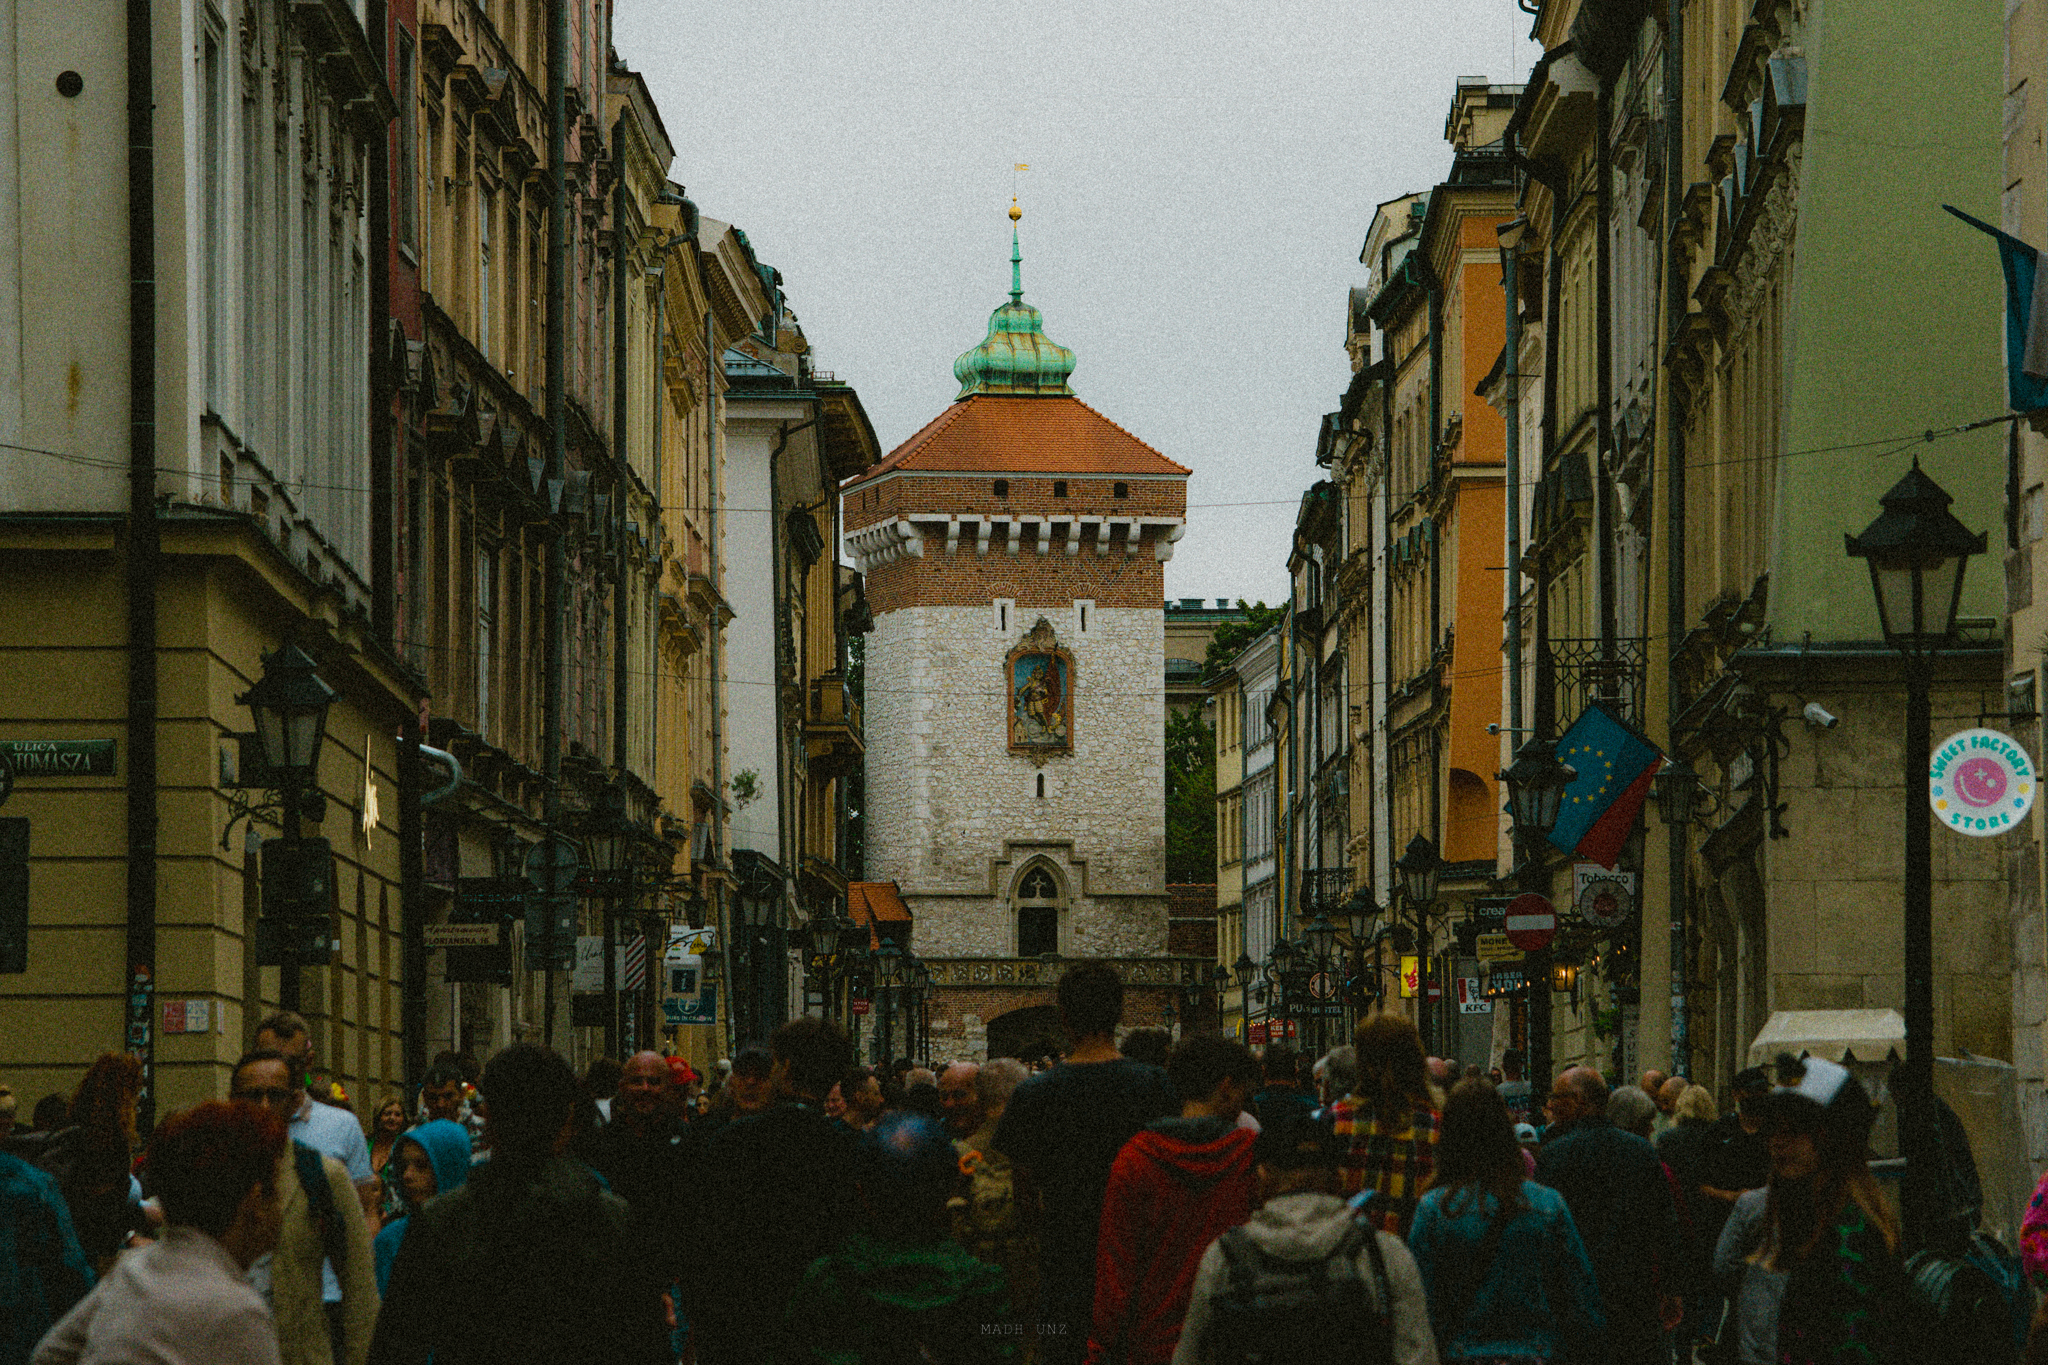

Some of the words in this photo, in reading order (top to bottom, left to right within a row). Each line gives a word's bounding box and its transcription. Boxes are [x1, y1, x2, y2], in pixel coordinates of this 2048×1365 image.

[13, 742, 58, 752] ULICA
[13, 752, 92, 772] TOMASZA
[1930, 739, 1966, 779] SWEET
[1970, 736, 2030, 776] FACTORY
[1951, 812, 2010, 831] STORE
[1580, 872, 1629, 885] Tobacco
[1465, 1003, 1487, 1012] KFC
